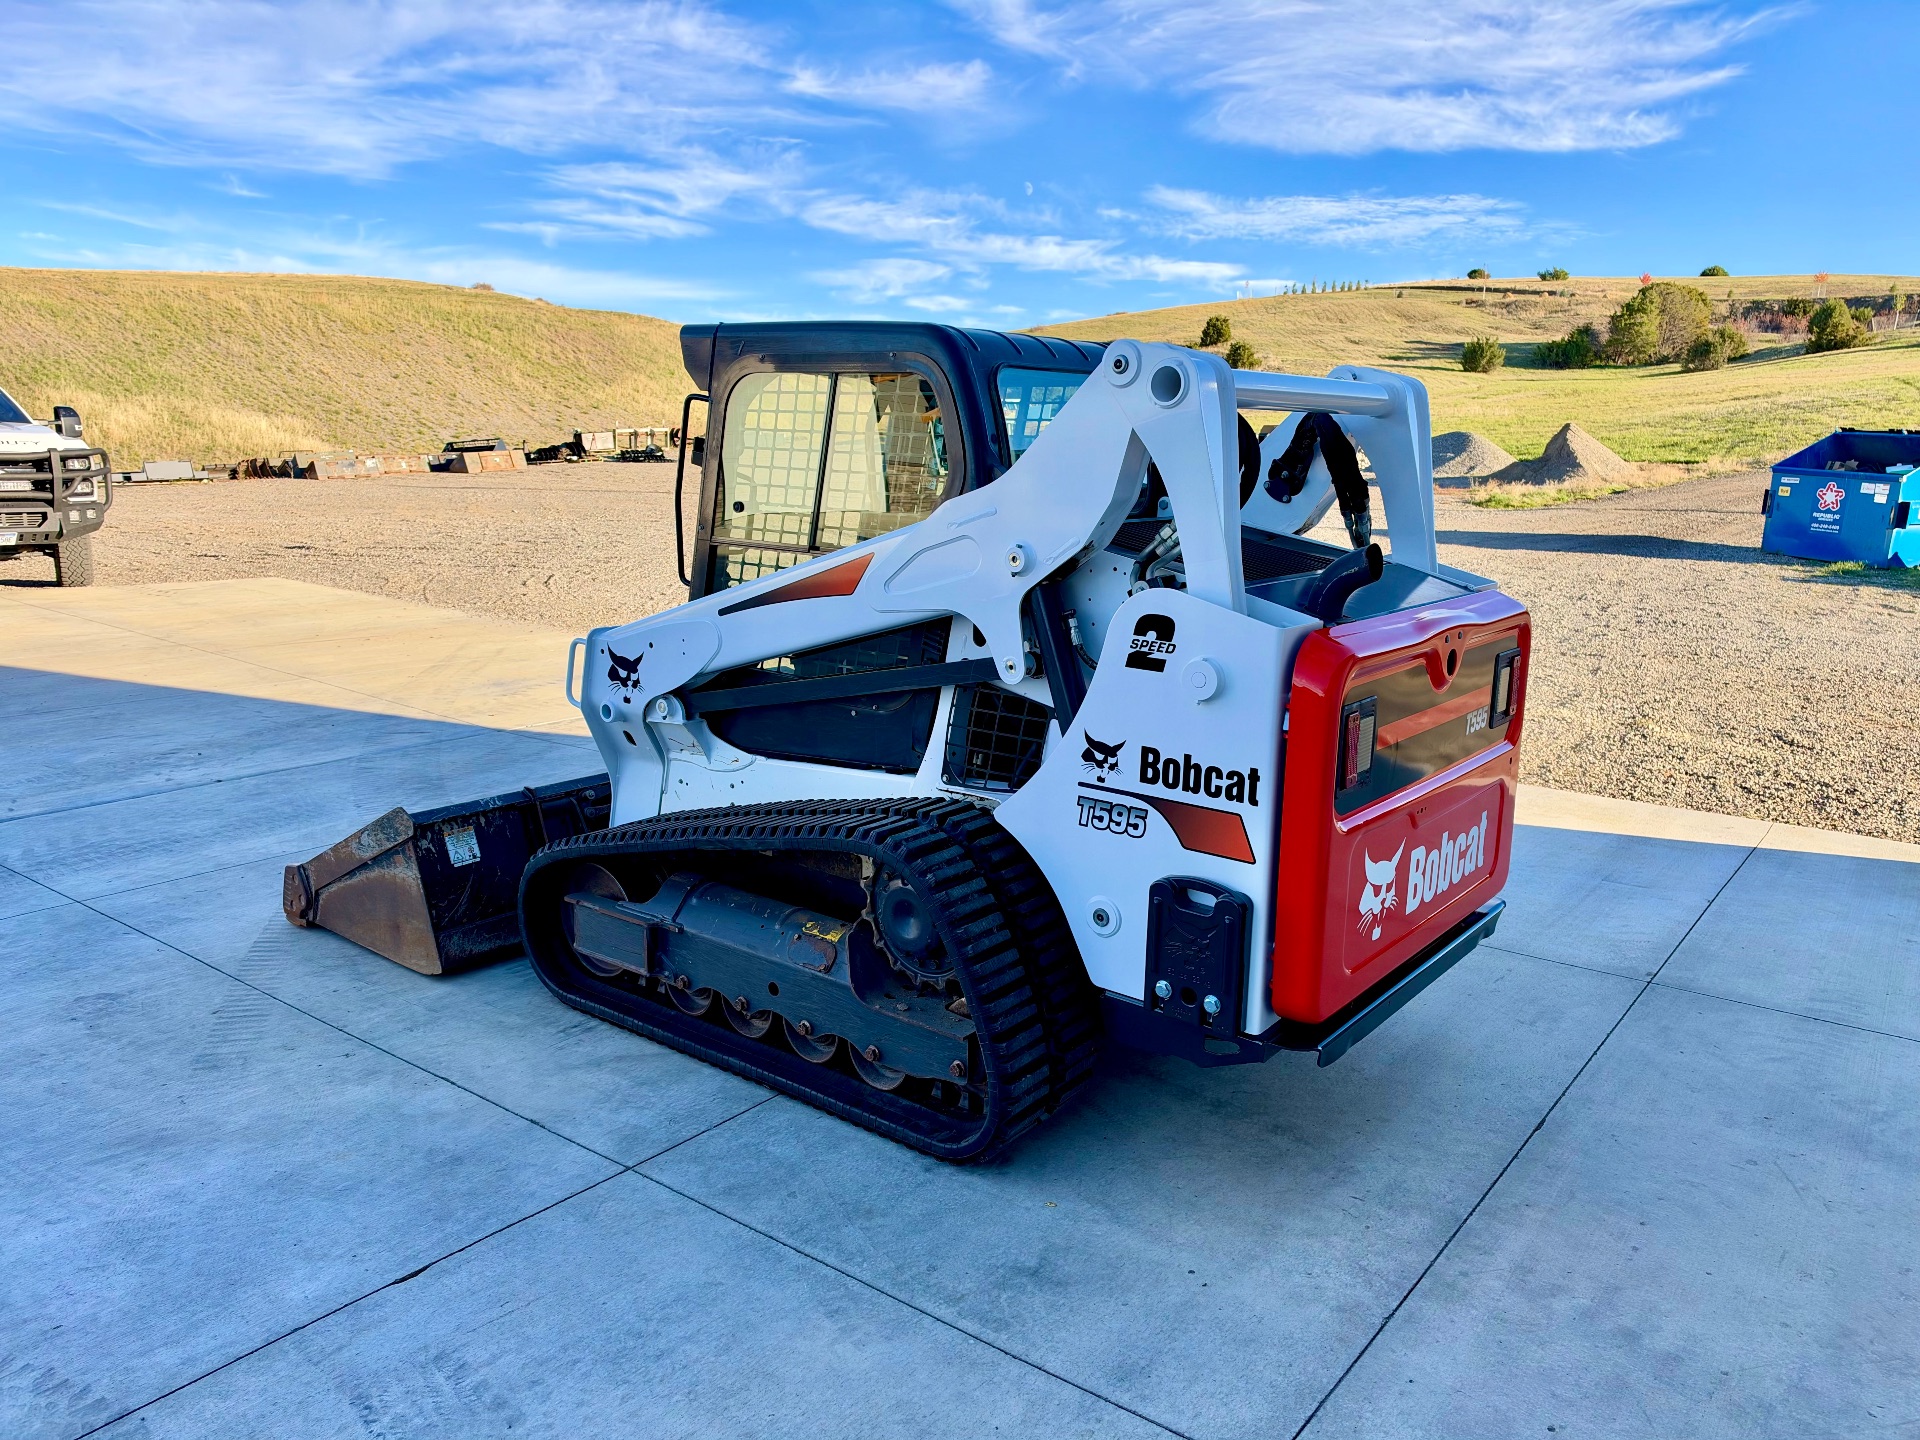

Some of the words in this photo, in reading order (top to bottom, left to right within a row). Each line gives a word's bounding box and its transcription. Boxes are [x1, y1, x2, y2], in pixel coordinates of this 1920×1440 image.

[1812, 512, 1840, 520] REPUBLIC
[1125, 613, 1176, 673] 2
[1129, 638, 1177, 654] SPEED
[1466, 705, 1489, 736] T595
[1139, 745, 1261, 807] Bobcat
[1077, 795, 1149, 839] T595
[1405, 810, 1488, 916] Bobcat
